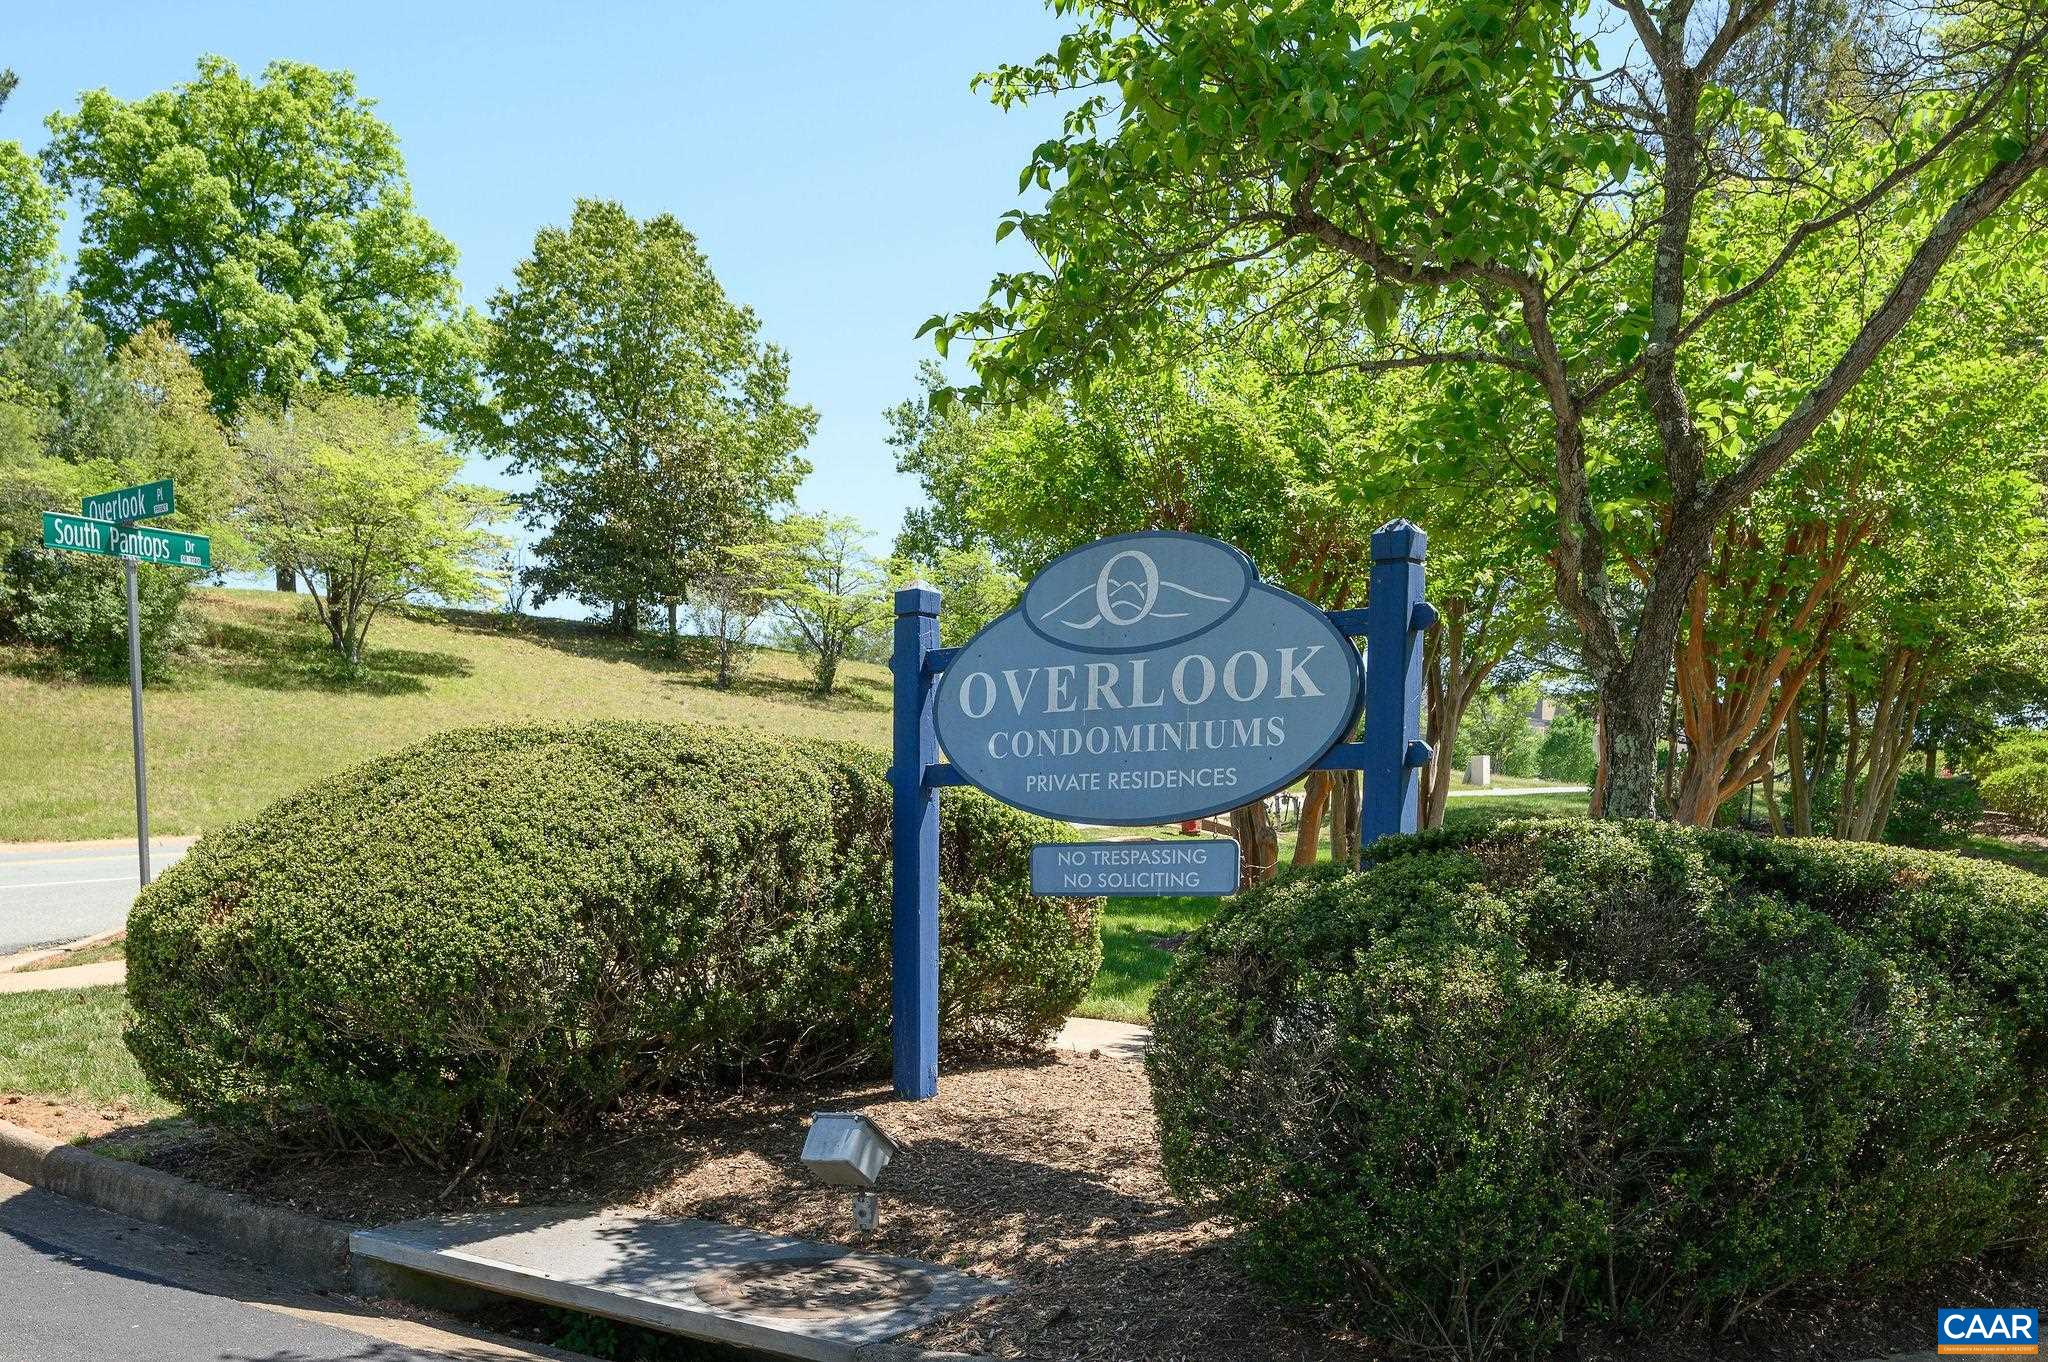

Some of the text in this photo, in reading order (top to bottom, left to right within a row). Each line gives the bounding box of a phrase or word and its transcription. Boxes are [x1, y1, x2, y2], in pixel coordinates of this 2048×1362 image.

[89, 488, 146, 521] Overlook
[156, 487, 164, 502] Pl
[54, 518, 196, 562] South Pantops Dr
[959, 644, 1326, 719] OVERLOOK
[987, 715, 1286, 760] CONDOMINIUMS
[1026, 767, 1238, 793] PRIVATE RESIDENCES
[1058, 848, 1208, 867] NO TRESPASSING
[1063, 871, 1200, 889] NO SOLICITING
